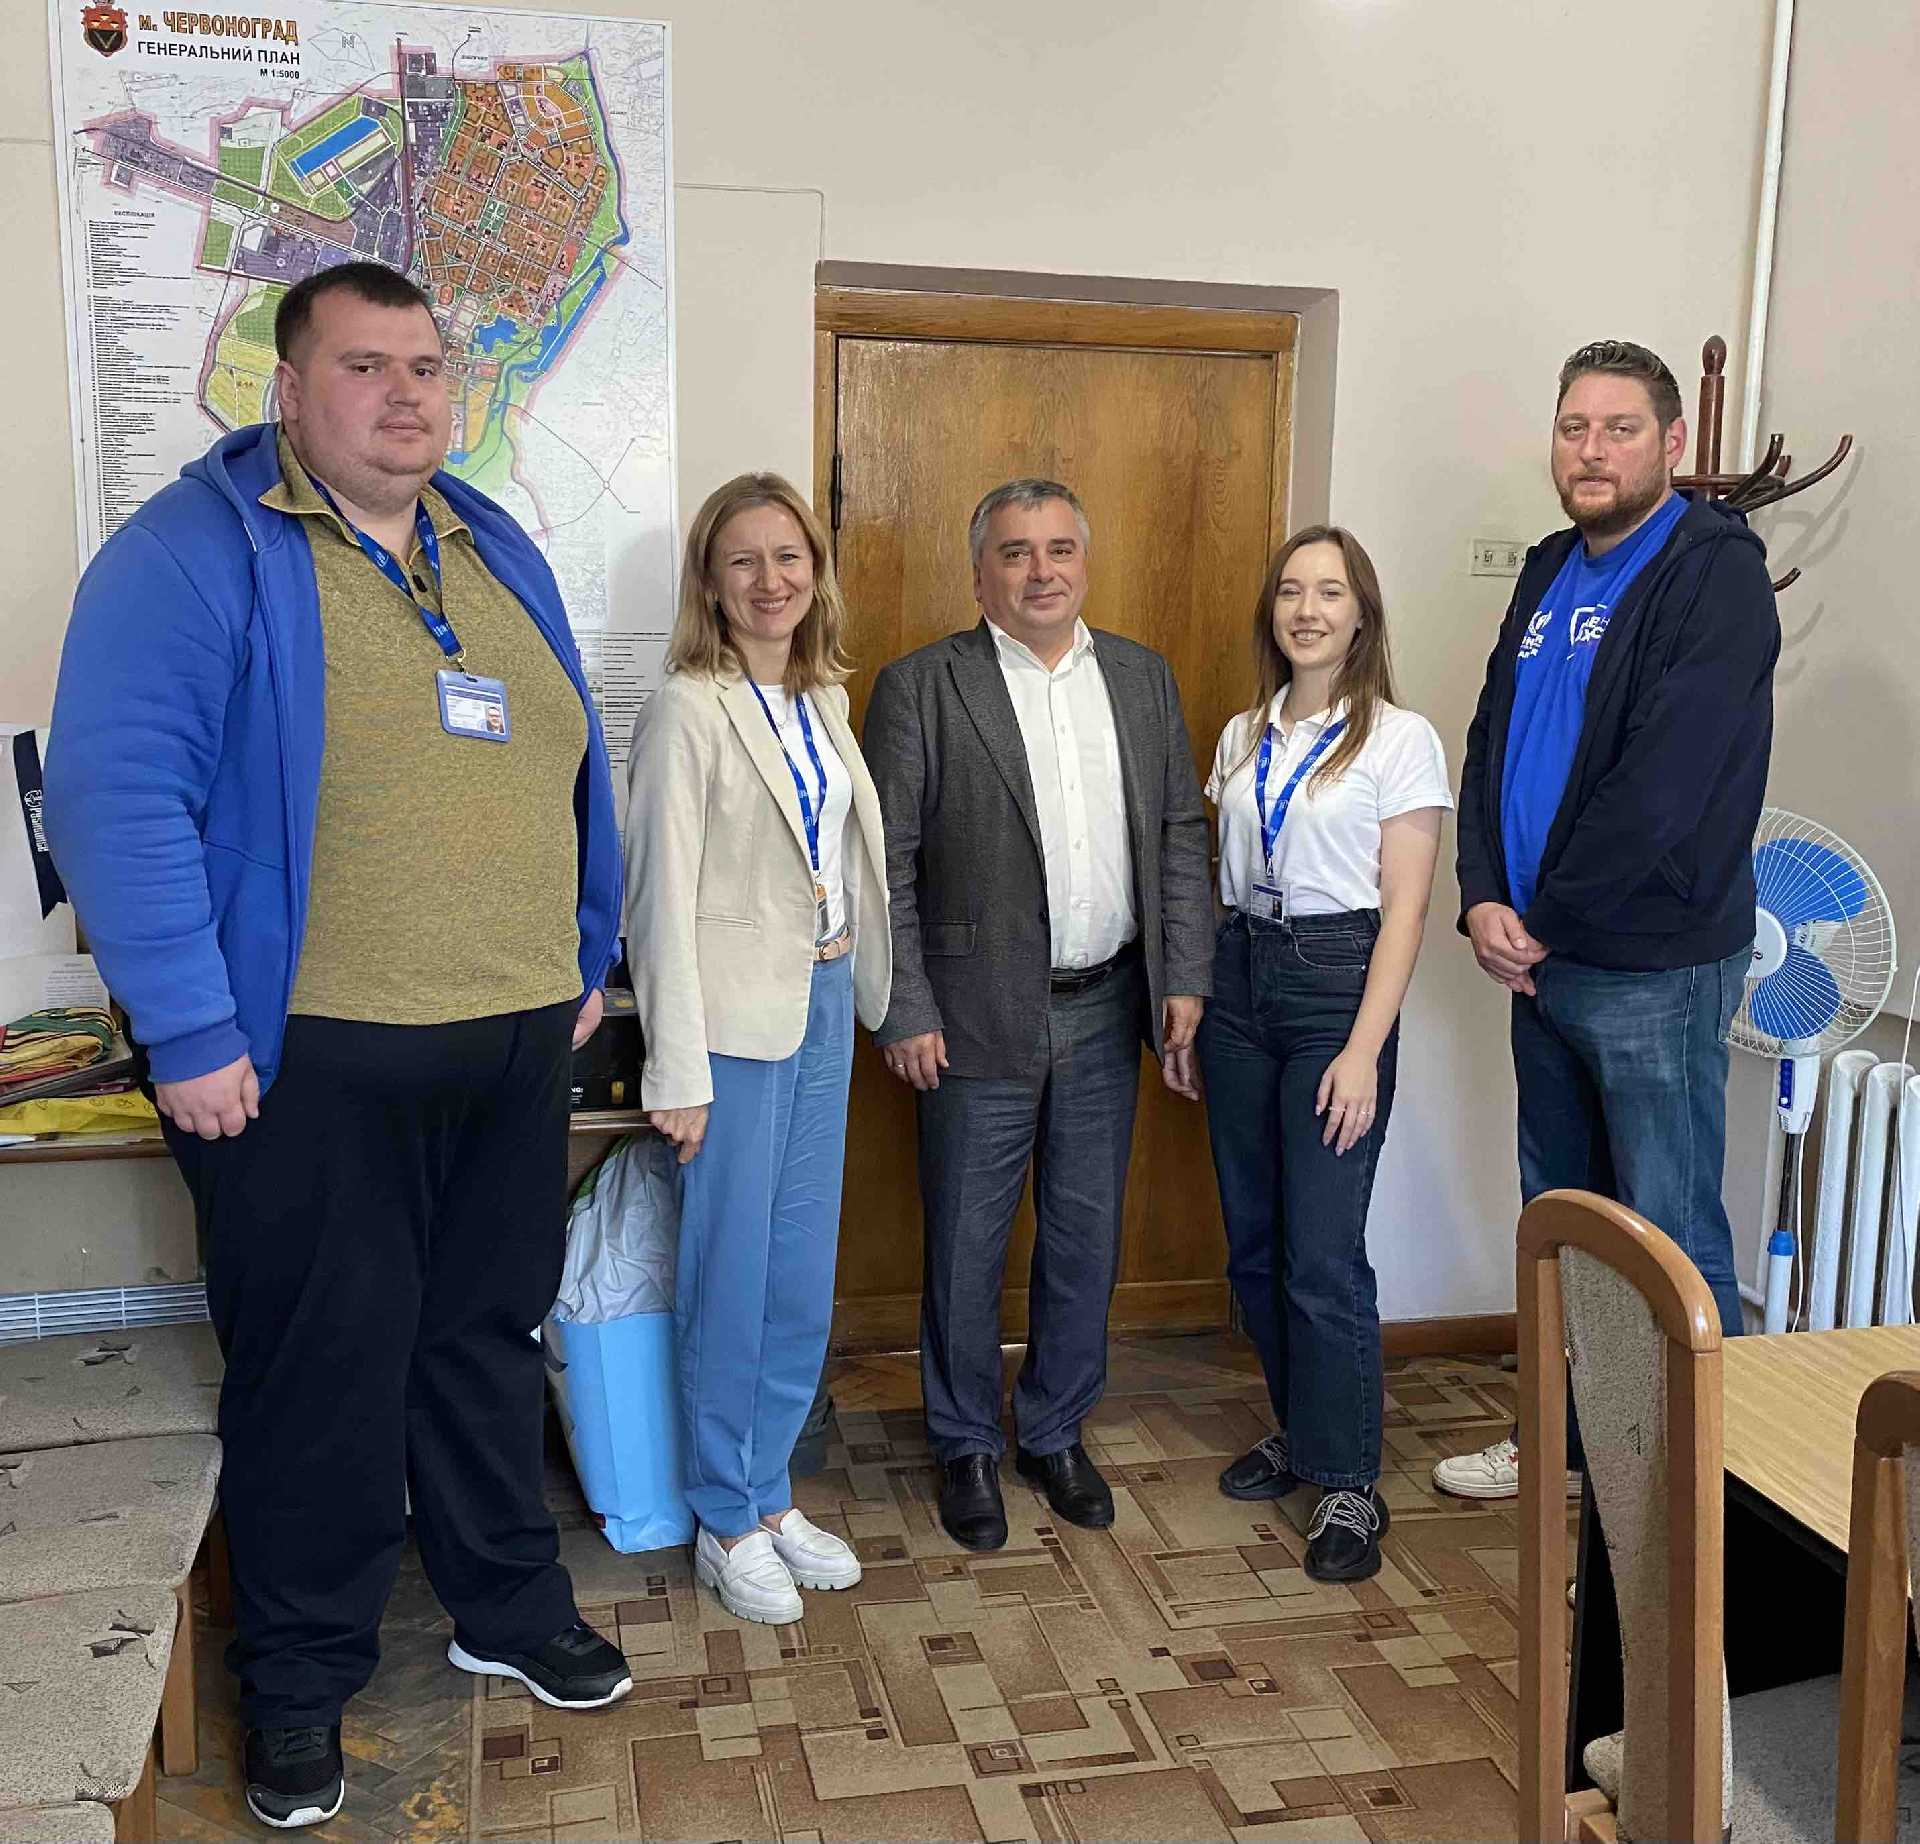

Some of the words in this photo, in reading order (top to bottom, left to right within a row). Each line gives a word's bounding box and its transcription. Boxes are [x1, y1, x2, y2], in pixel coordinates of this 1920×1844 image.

[163, 10, 299, 46] ЧЕРВОНОГРАД
[138, 40, 252, 62] ГЕНЕРАЛЬНИЙ
[257, 49, 300, 65] ПЛАН
[271, 69, 300, 79] 1:5000
